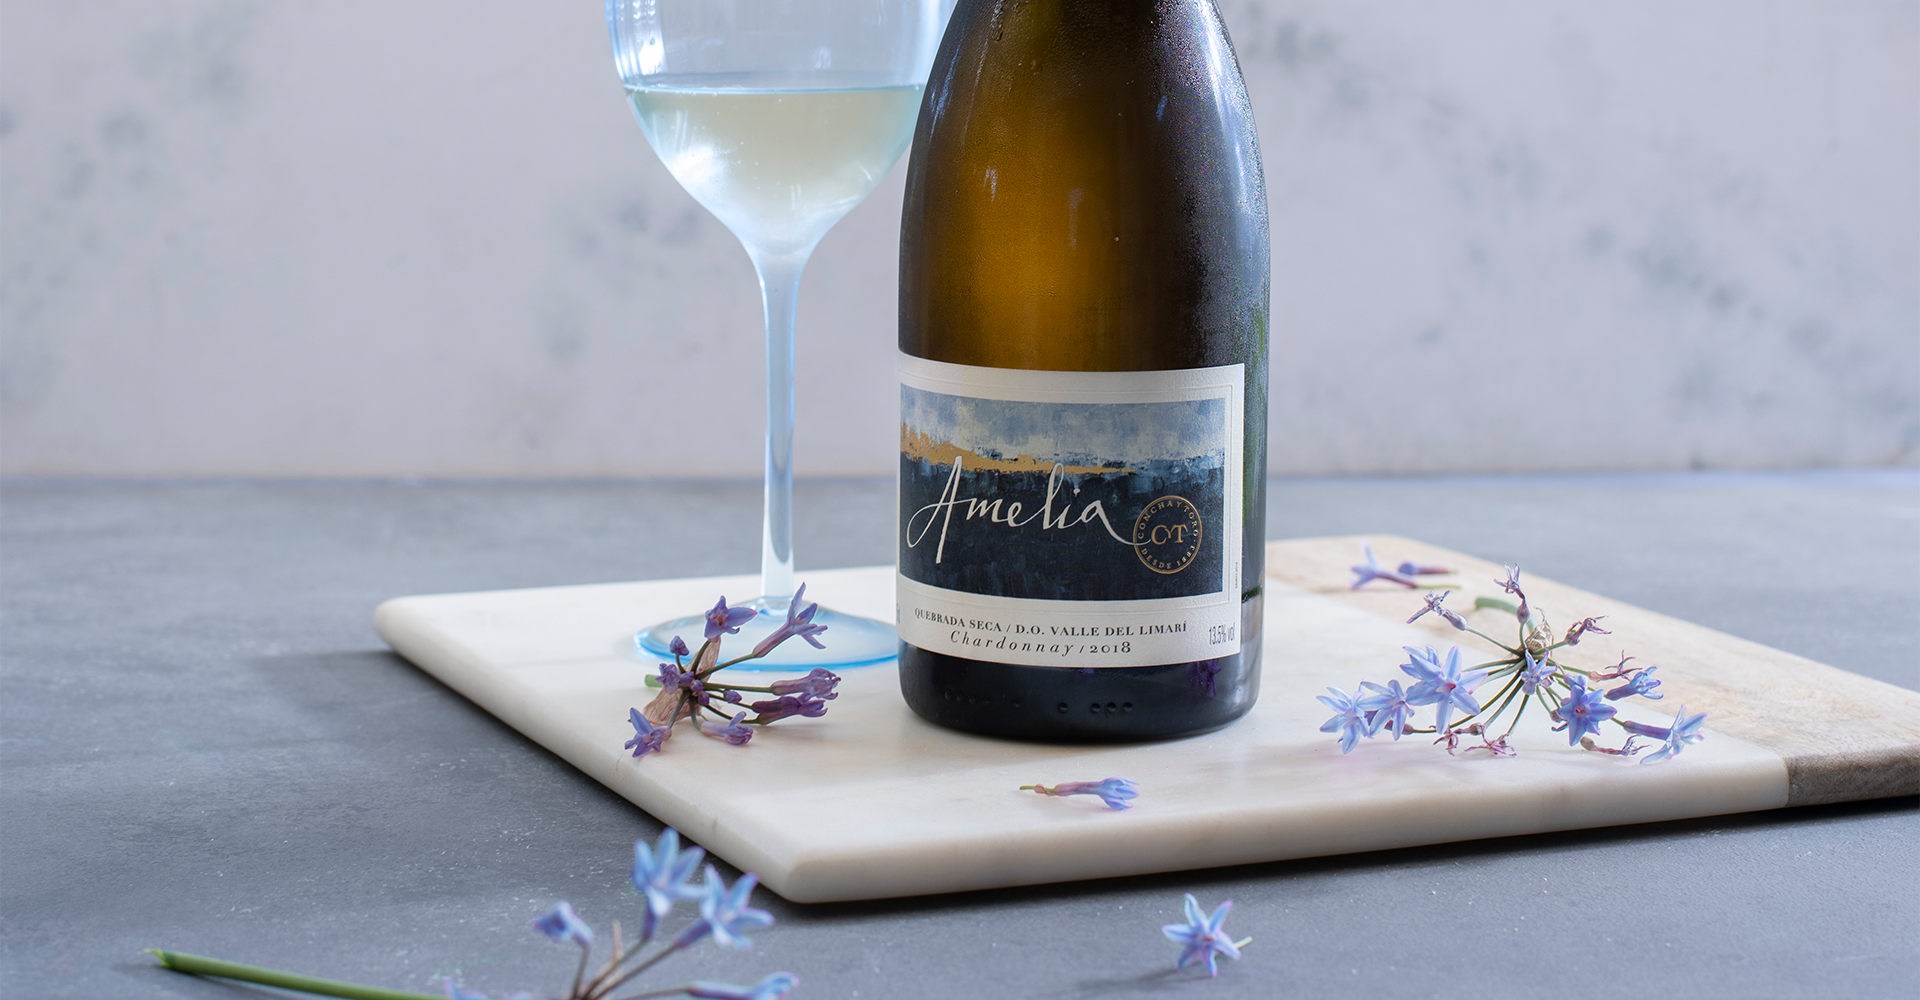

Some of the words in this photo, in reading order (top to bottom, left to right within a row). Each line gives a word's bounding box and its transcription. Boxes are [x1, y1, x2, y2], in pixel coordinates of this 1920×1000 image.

[906, 455, 1151, 564] Amelia
[914, 607, 965, 628] QUEBRADA
[969, 619, 1002, 632] SECA
[1015, 624, 1045, 636] D.O.
[1050, 625, 1100, 637] VALLE
[1105, 625, 1134, 637] DEL
[1139, 620, 1187, 636] LIMARÍ
[1208, 624, 1227, 645] 13.5%
[950, 630, 1074, 657] Chardonnay
[1090, 641, 1131, 654] 2018
